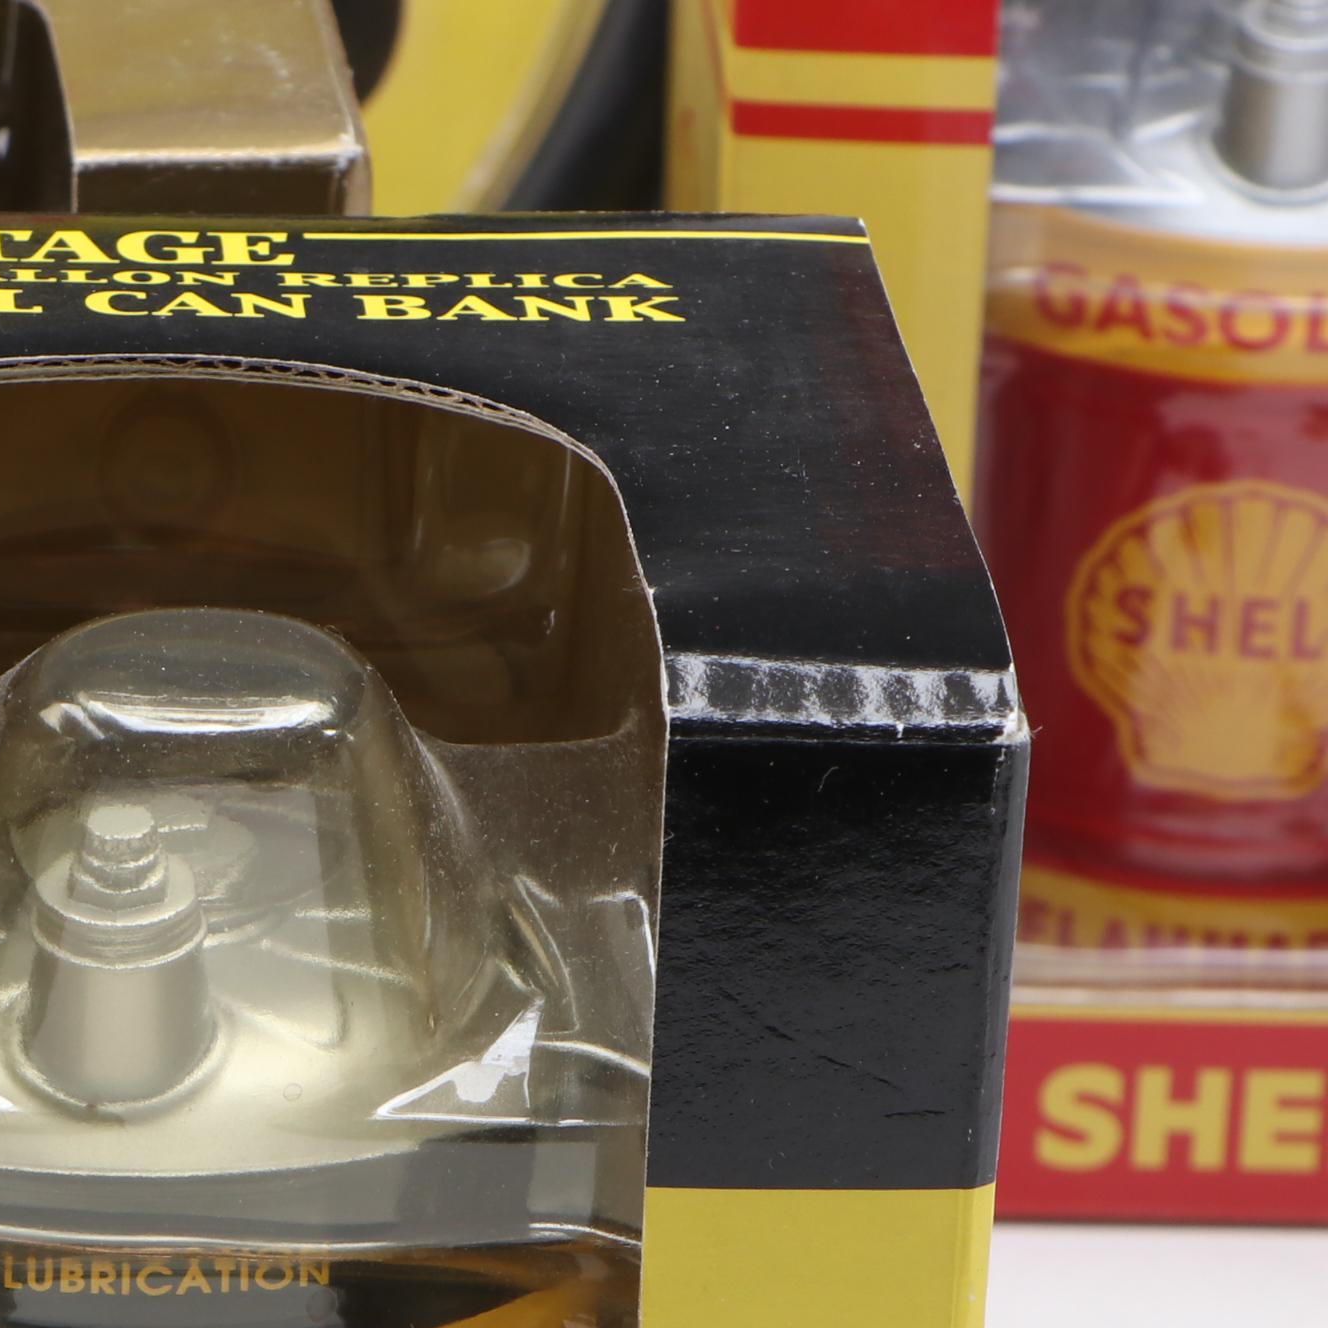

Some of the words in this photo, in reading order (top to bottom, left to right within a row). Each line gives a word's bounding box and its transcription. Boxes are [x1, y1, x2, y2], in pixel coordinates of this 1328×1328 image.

[276, 272, 673, 288] REPLICA
[84, 290, 312, 319] CAN
[352, 294, 686, 322] BANK
[1034, 1062, 1324, 1172] SHE
[3, 1248, 331, 1297] LUBRICATION
